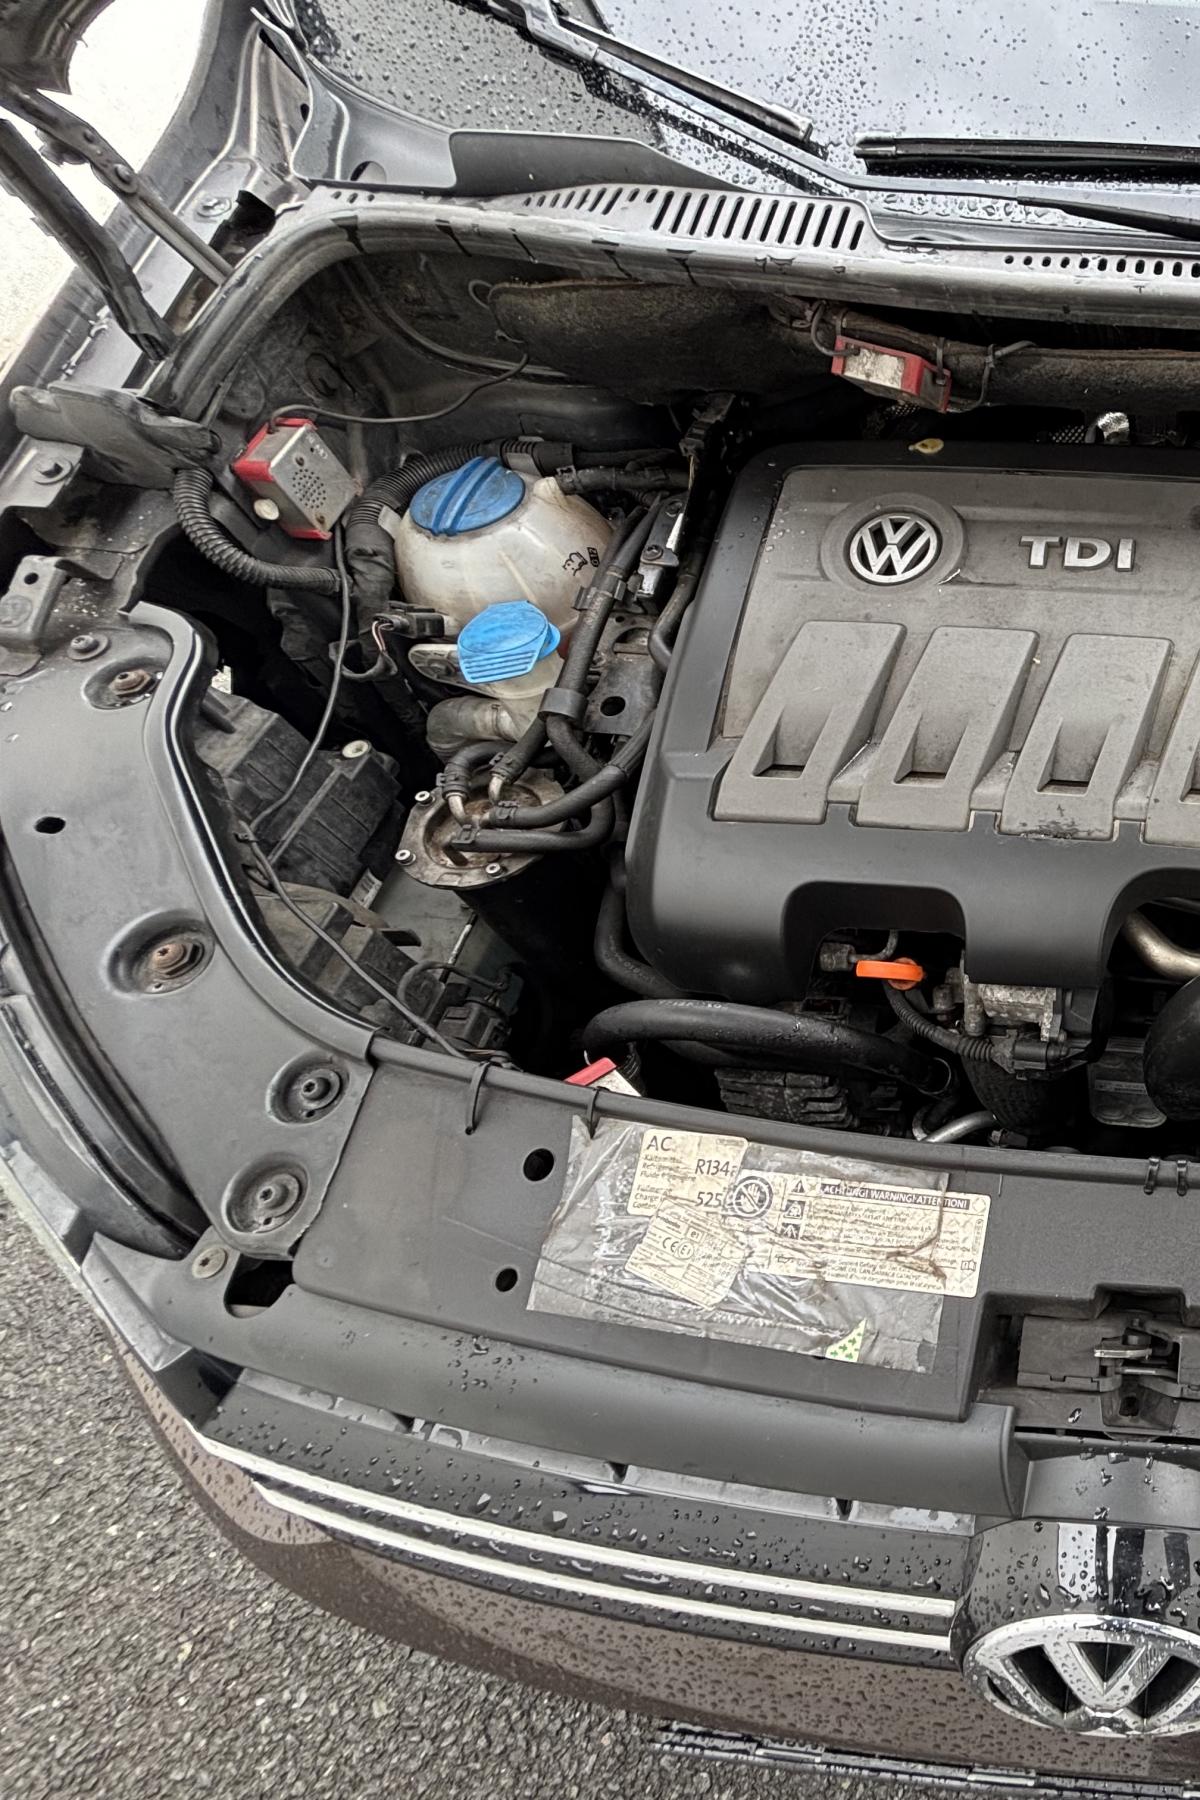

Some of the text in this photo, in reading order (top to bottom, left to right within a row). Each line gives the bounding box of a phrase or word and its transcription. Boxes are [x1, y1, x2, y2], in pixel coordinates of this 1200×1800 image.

[849, 512, 938, 585] VW
[1019, 535, 1137, 572] TDI
[646, 1135, 673, 1152] AC
